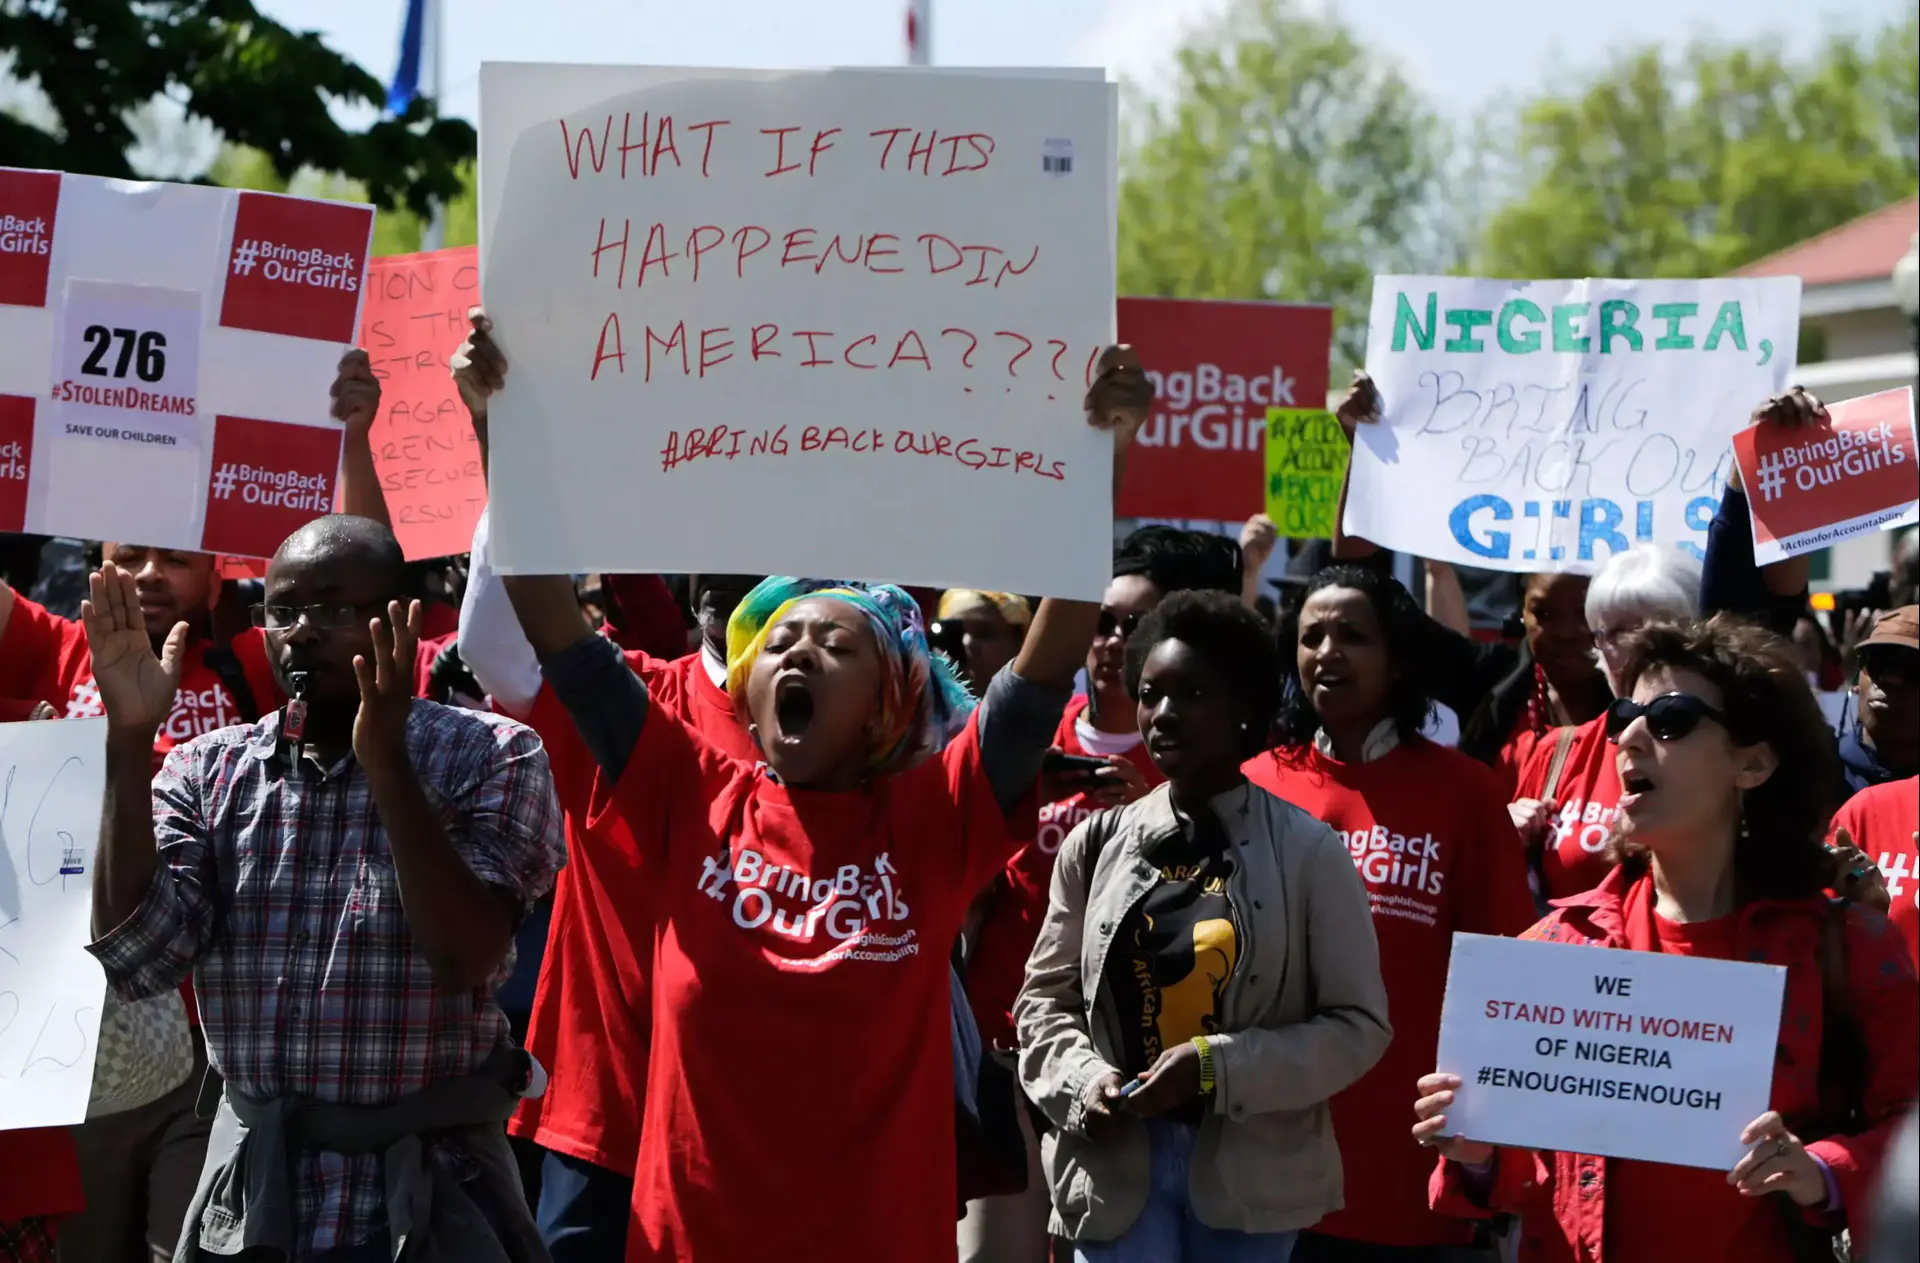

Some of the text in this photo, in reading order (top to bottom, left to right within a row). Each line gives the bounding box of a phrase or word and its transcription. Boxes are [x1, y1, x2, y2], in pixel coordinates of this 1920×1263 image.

[560, 111, 731, 179] WHAT
[760, 127, 842, 177] IF
[870, 129, 995, 176] THIS
[232, 239, 354, 276] #BringBack
[263, 259, 358, 292] OurGirls
[1391, 291, 1774, 366] NIGERIA,
[80, 324, 167, 383] 276
[1416, 370, 1648, 440] BRING
[65, 423, 177, 446] SAVE OUR CHILDREN
[213, 463, 327, 499] #BringBack
[1756, 420, 1895, 502] #BringBack
[1795, 440, 1905, 491] OurGirls
[242, 483, 330, 512] OurGirls
[1133, 959, 1157, 1027] African
[1594, 975, 1632, 996] WE
[1485, 1000, 1733, 1044] STAND WITH WOMEN
[1535, 1037, 1672, 1069] OF NIGERIA
[1477, 1066, 1721, 1110] #ENOUGHISENOUGH
